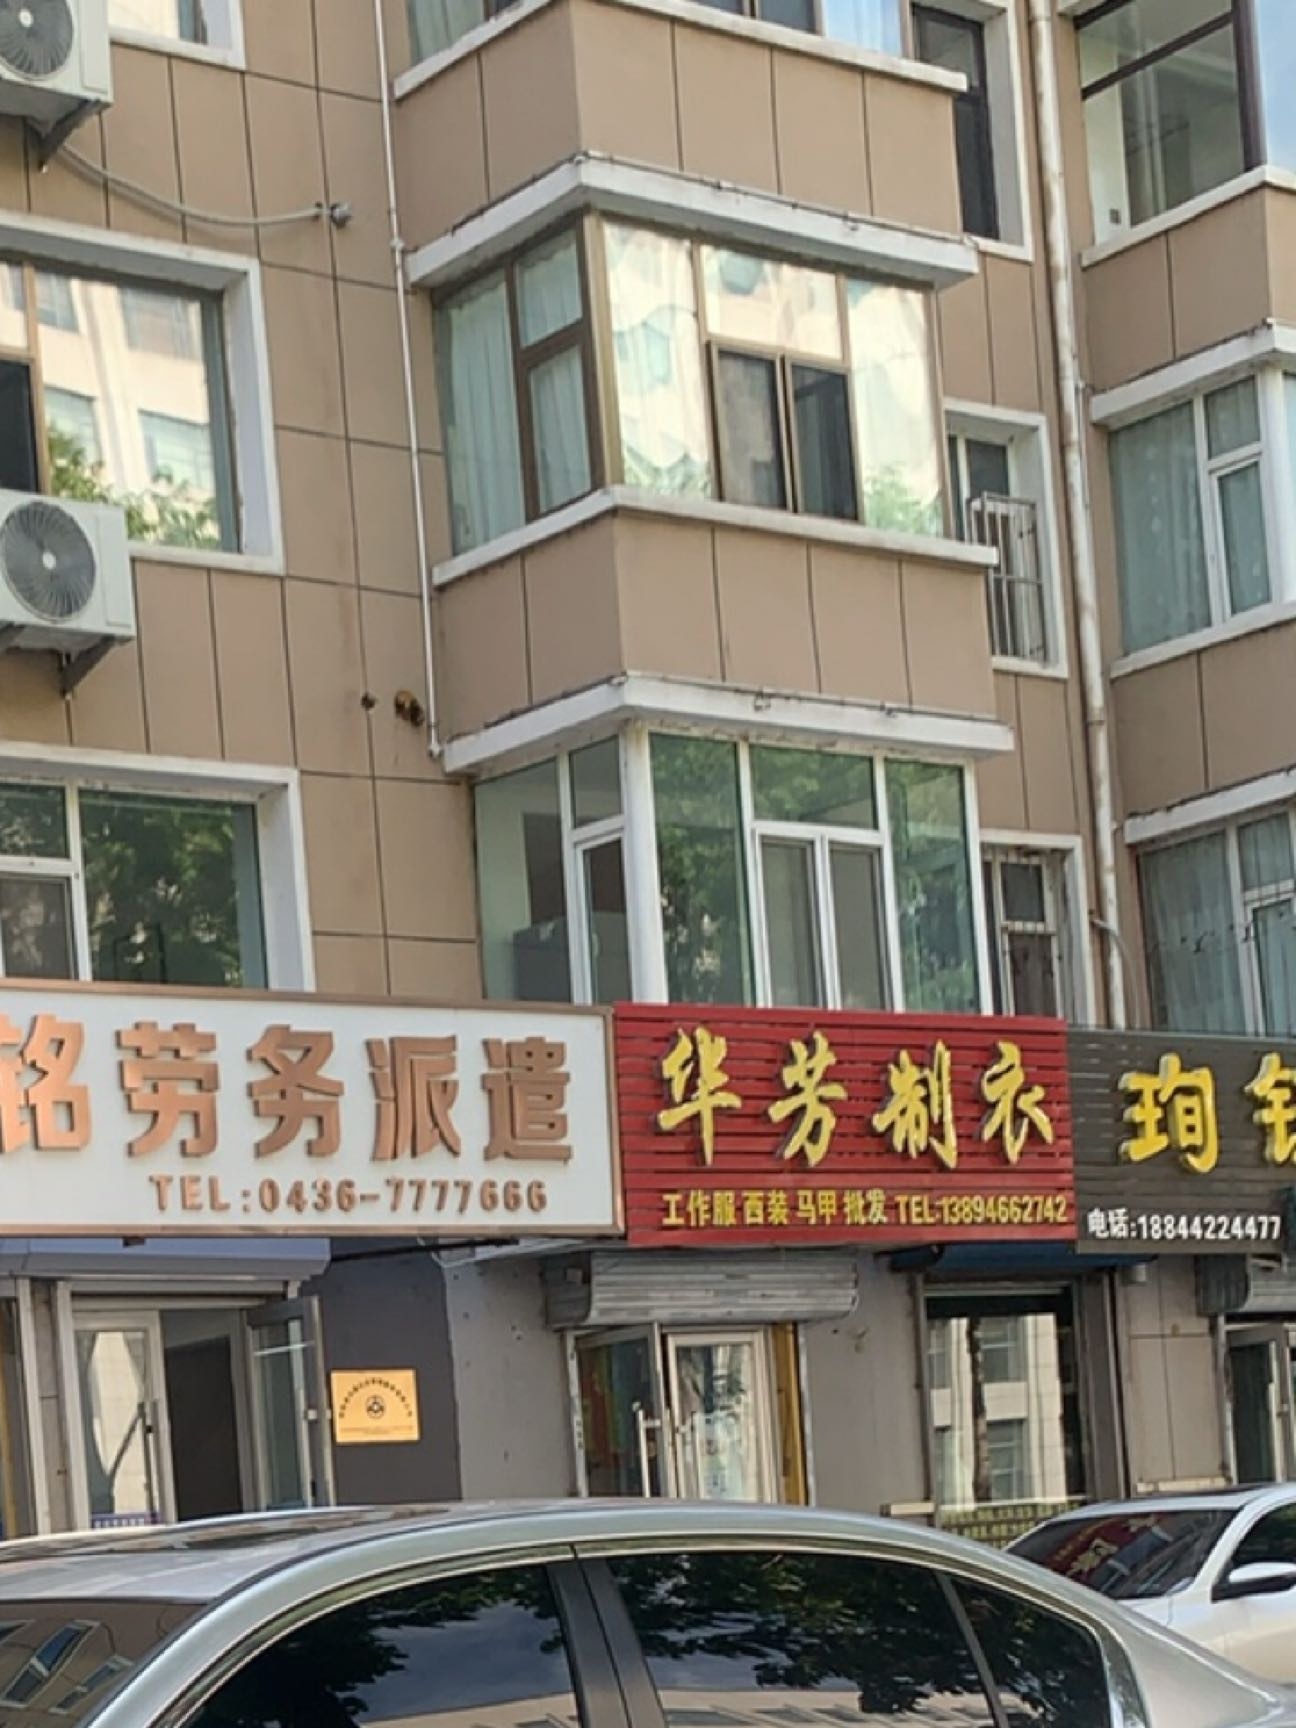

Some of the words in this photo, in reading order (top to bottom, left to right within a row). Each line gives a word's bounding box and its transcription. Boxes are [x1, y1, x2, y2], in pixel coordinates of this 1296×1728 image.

[657, 1026, 1054, 1170] 华芳制衣
[149, 1174, 548, 1213] TEL:0436-7777666
[661, 1190, 737, 1226] 工作服
[742, 1190, 789, 1225] 西装
[796, 1189, 838, 1225] 马甲
[843, 1188, 890, 1225] 批发
[895, 1194, 1068, 1225] TEL:13894662742
[1087, 1207, 1282, 1240] 电话:18844224477
